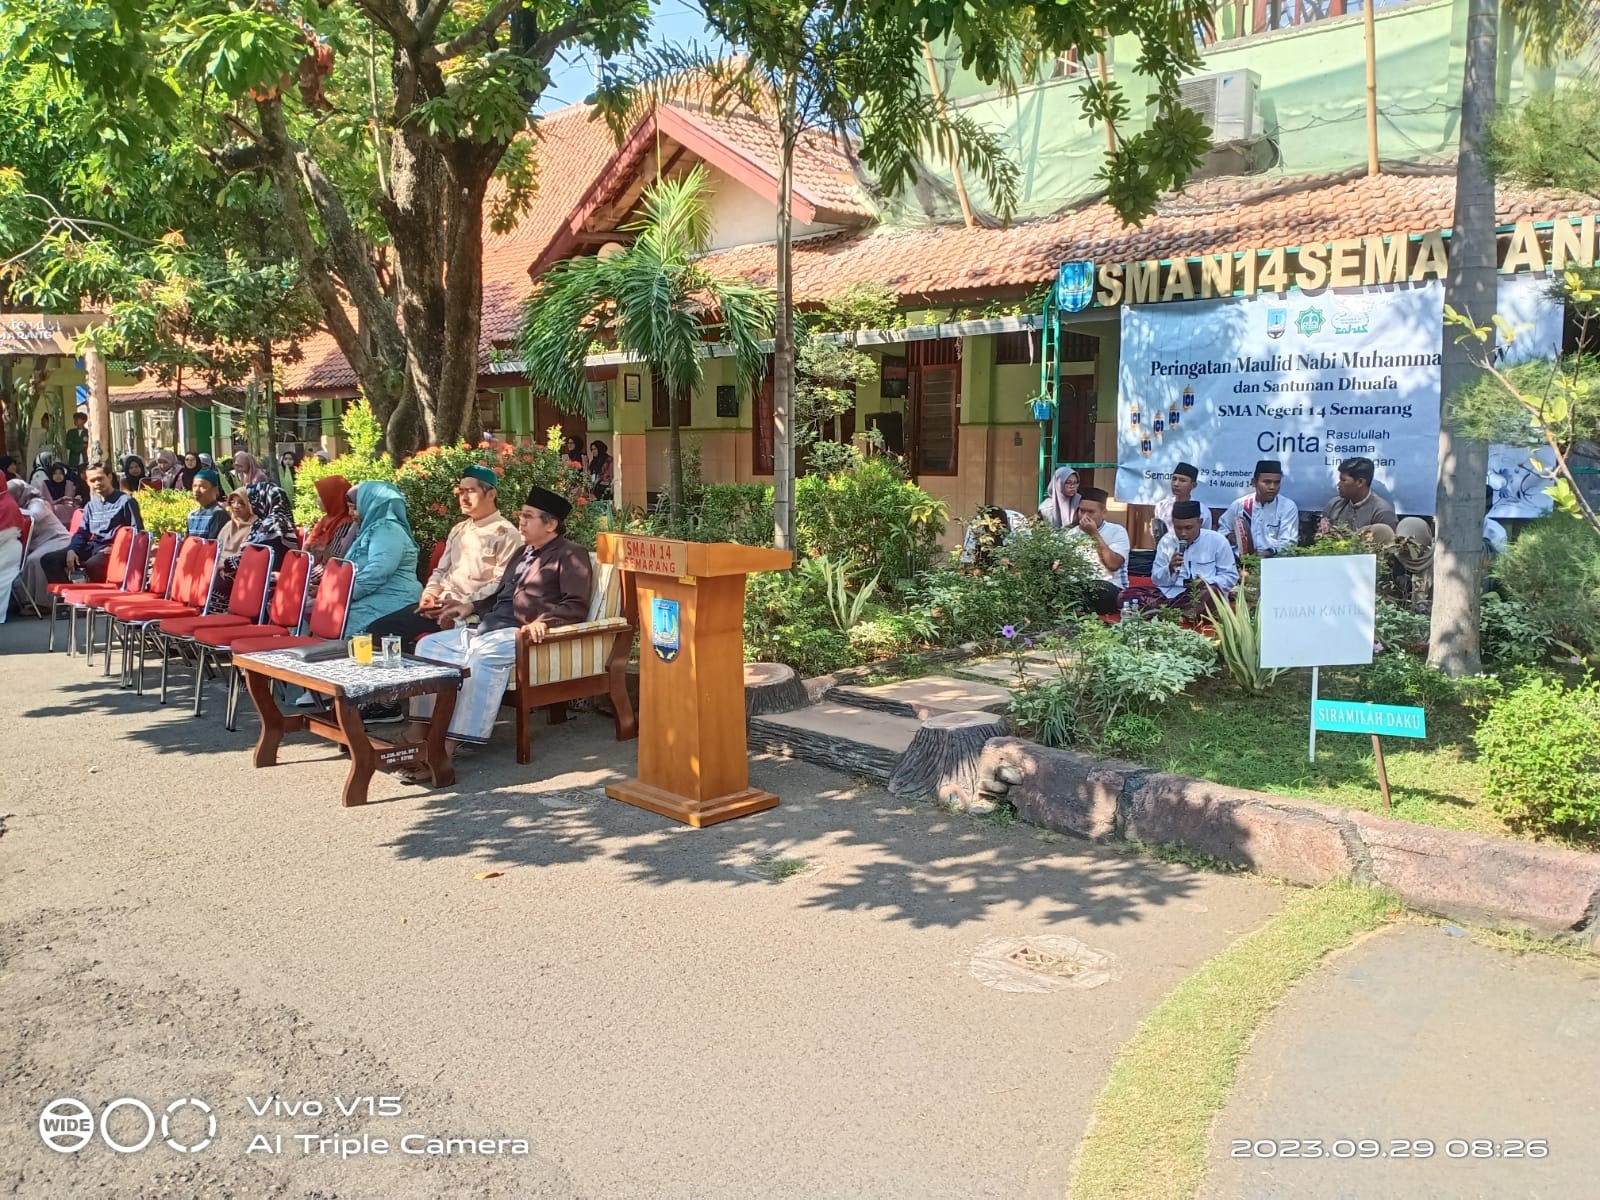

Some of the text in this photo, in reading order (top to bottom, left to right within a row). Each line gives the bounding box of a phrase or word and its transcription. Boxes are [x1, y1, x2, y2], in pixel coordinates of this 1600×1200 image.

[1151, 349, 1442, 379] Peringatan Maulid Nabi Muhamma
[1233, 375, 1398, 394] dan Santunan Dhuafa
[1218, 402, 1413, 419] SMA Negeri 14 Semarang
[1257, 431, 1320, 453] Cinta
[1326, 429, 1390, 440] Rasulullah
[1325, 443, 1376, 453] Sesama
[1144, 470, 1174, 480] Semar
[1200, 468, 1253, 479] 29 September
[1209, 479, 1218, 487] 14
[1220, 480, 1244, 488] Maulid
[626, 541, 671, 560] SMA N 14
[624, 557, 676, 573] SEMARANG
[1272, 606, 1316, 619] TAMAN
[1318, 707, 1420, 729] SIRAMILAH DAKU
